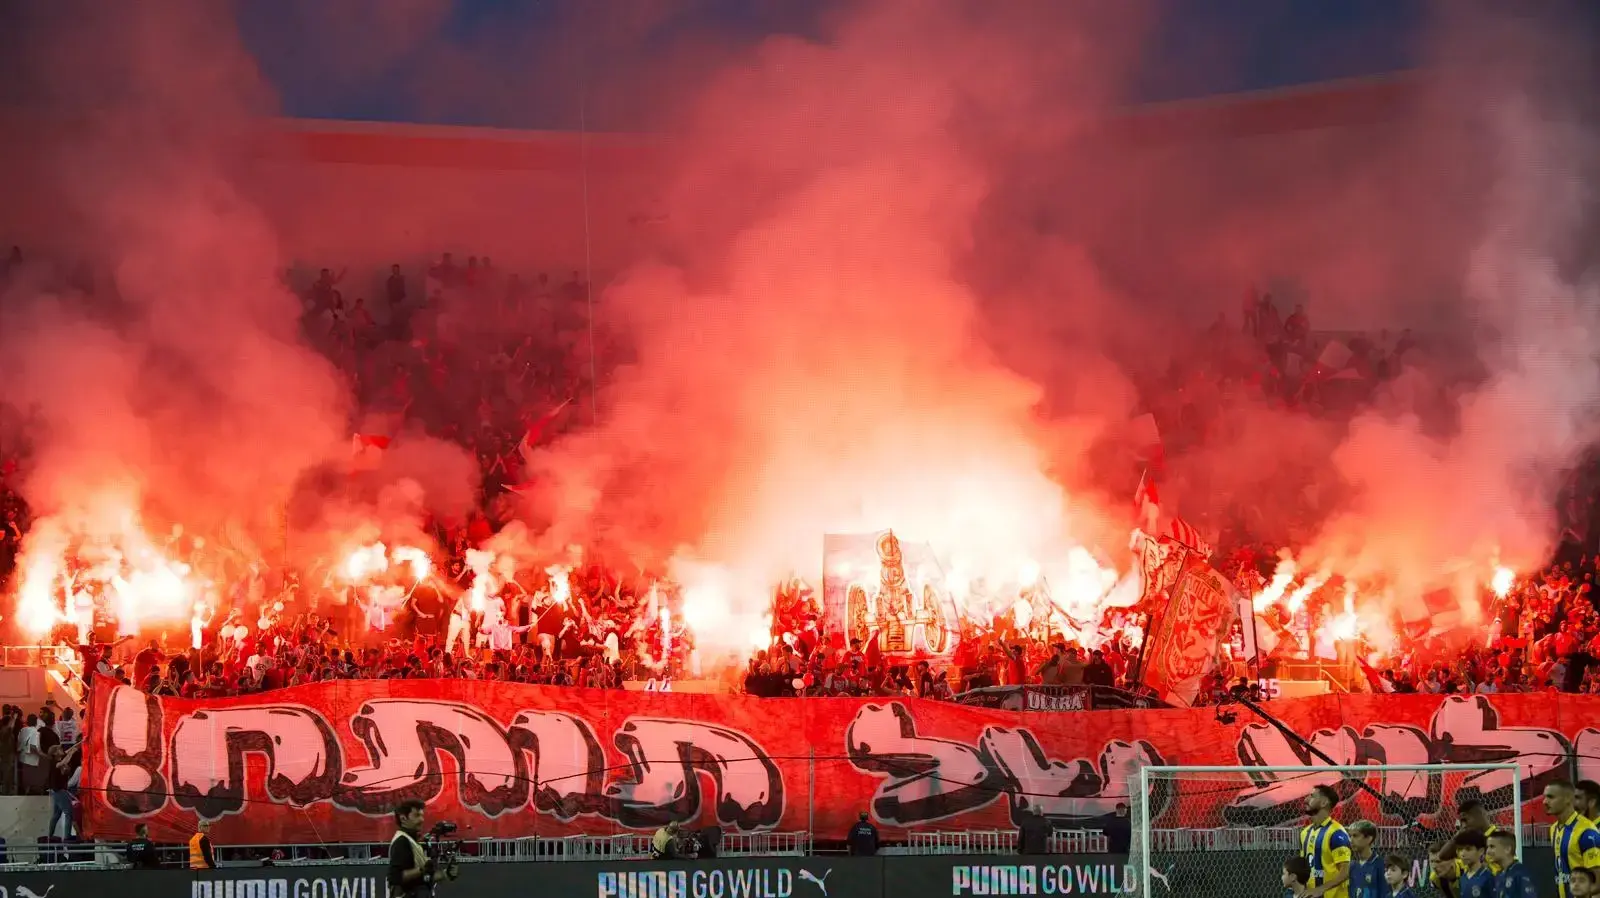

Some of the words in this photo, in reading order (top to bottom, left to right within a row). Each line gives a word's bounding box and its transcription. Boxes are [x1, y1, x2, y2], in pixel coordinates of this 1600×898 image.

[331, 877, 392, 898] WIL
[598, 871, 687, 898] PUMA
[952, 865, 1037, 895] PUMA
